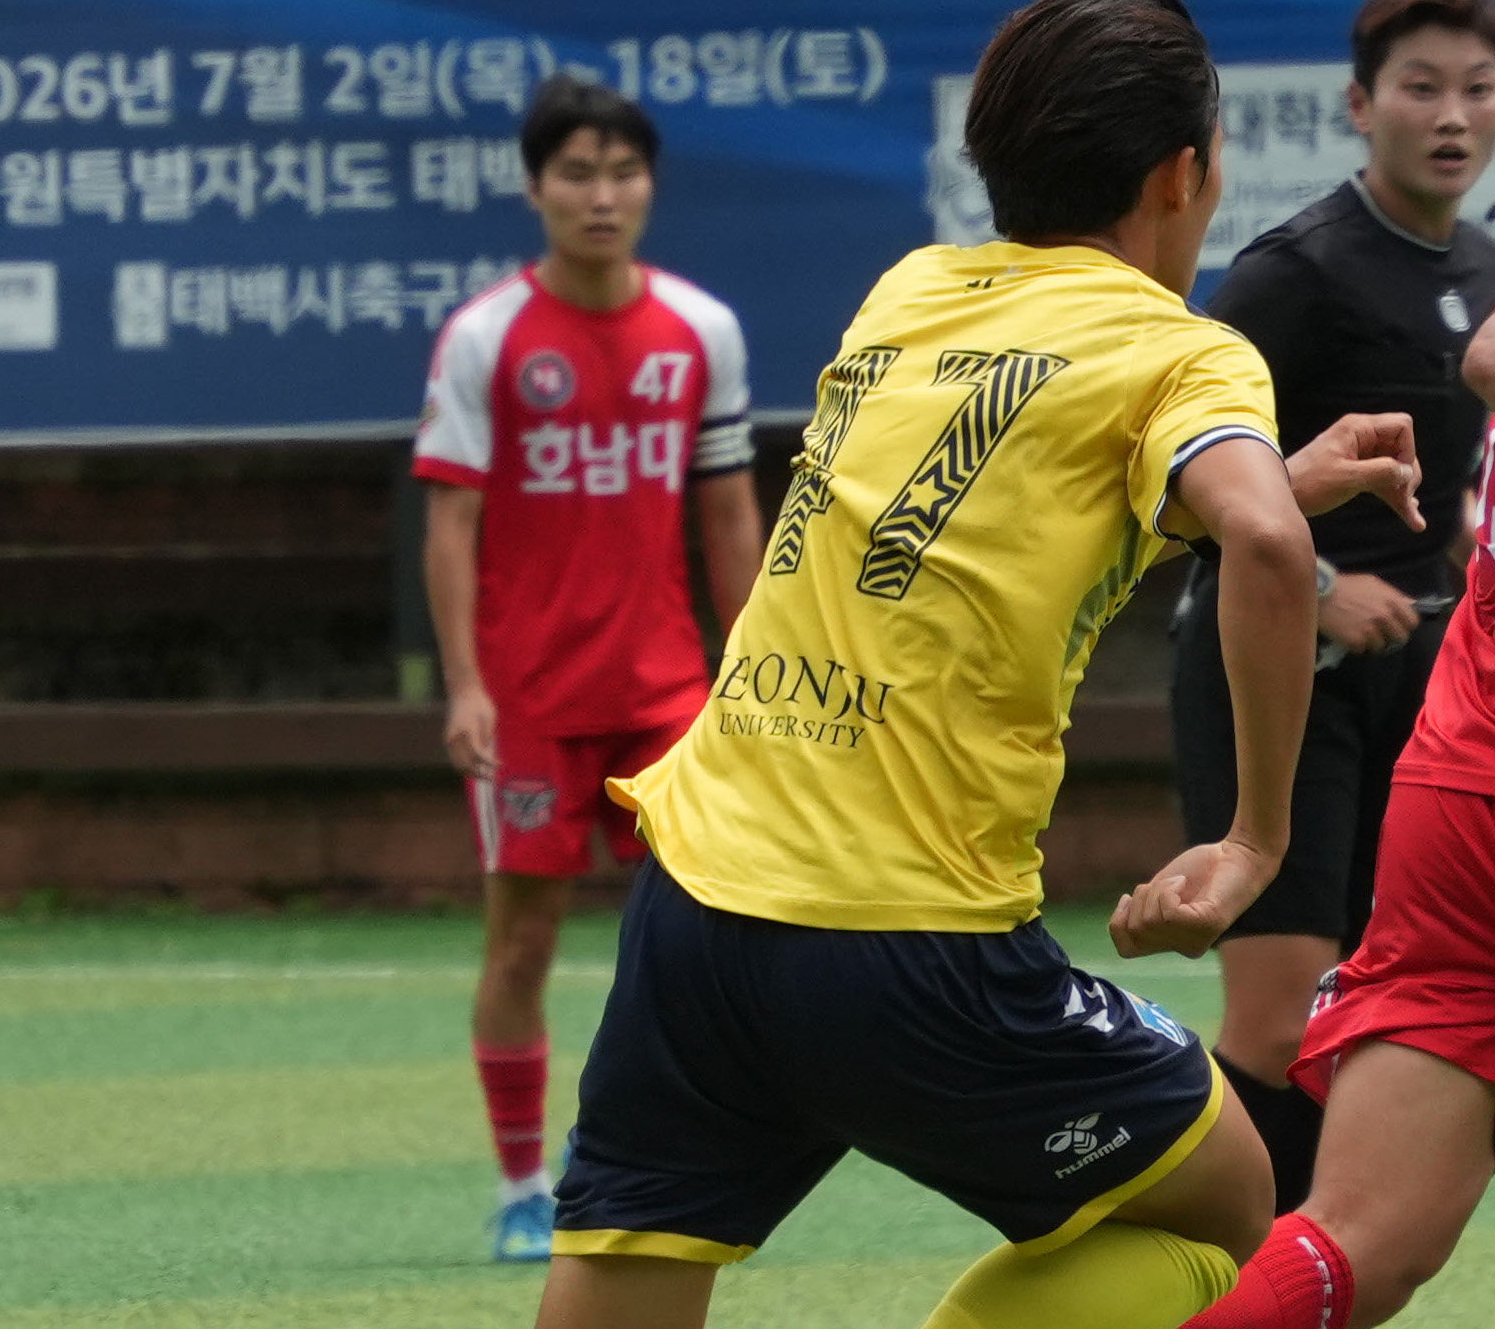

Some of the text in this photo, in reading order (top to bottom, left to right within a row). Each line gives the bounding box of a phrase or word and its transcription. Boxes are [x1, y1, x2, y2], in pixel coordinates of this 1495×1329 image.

[191, 44, 302, 124] 7월
[631, 351, 693, 405] 47
[520, 421, 686, 496] 호남대
[710, 652, 896, 725] EONJU
[719, 712, 866, 749] UNIVERSITY
[1055, 1126, 1132, 1180] hummel
